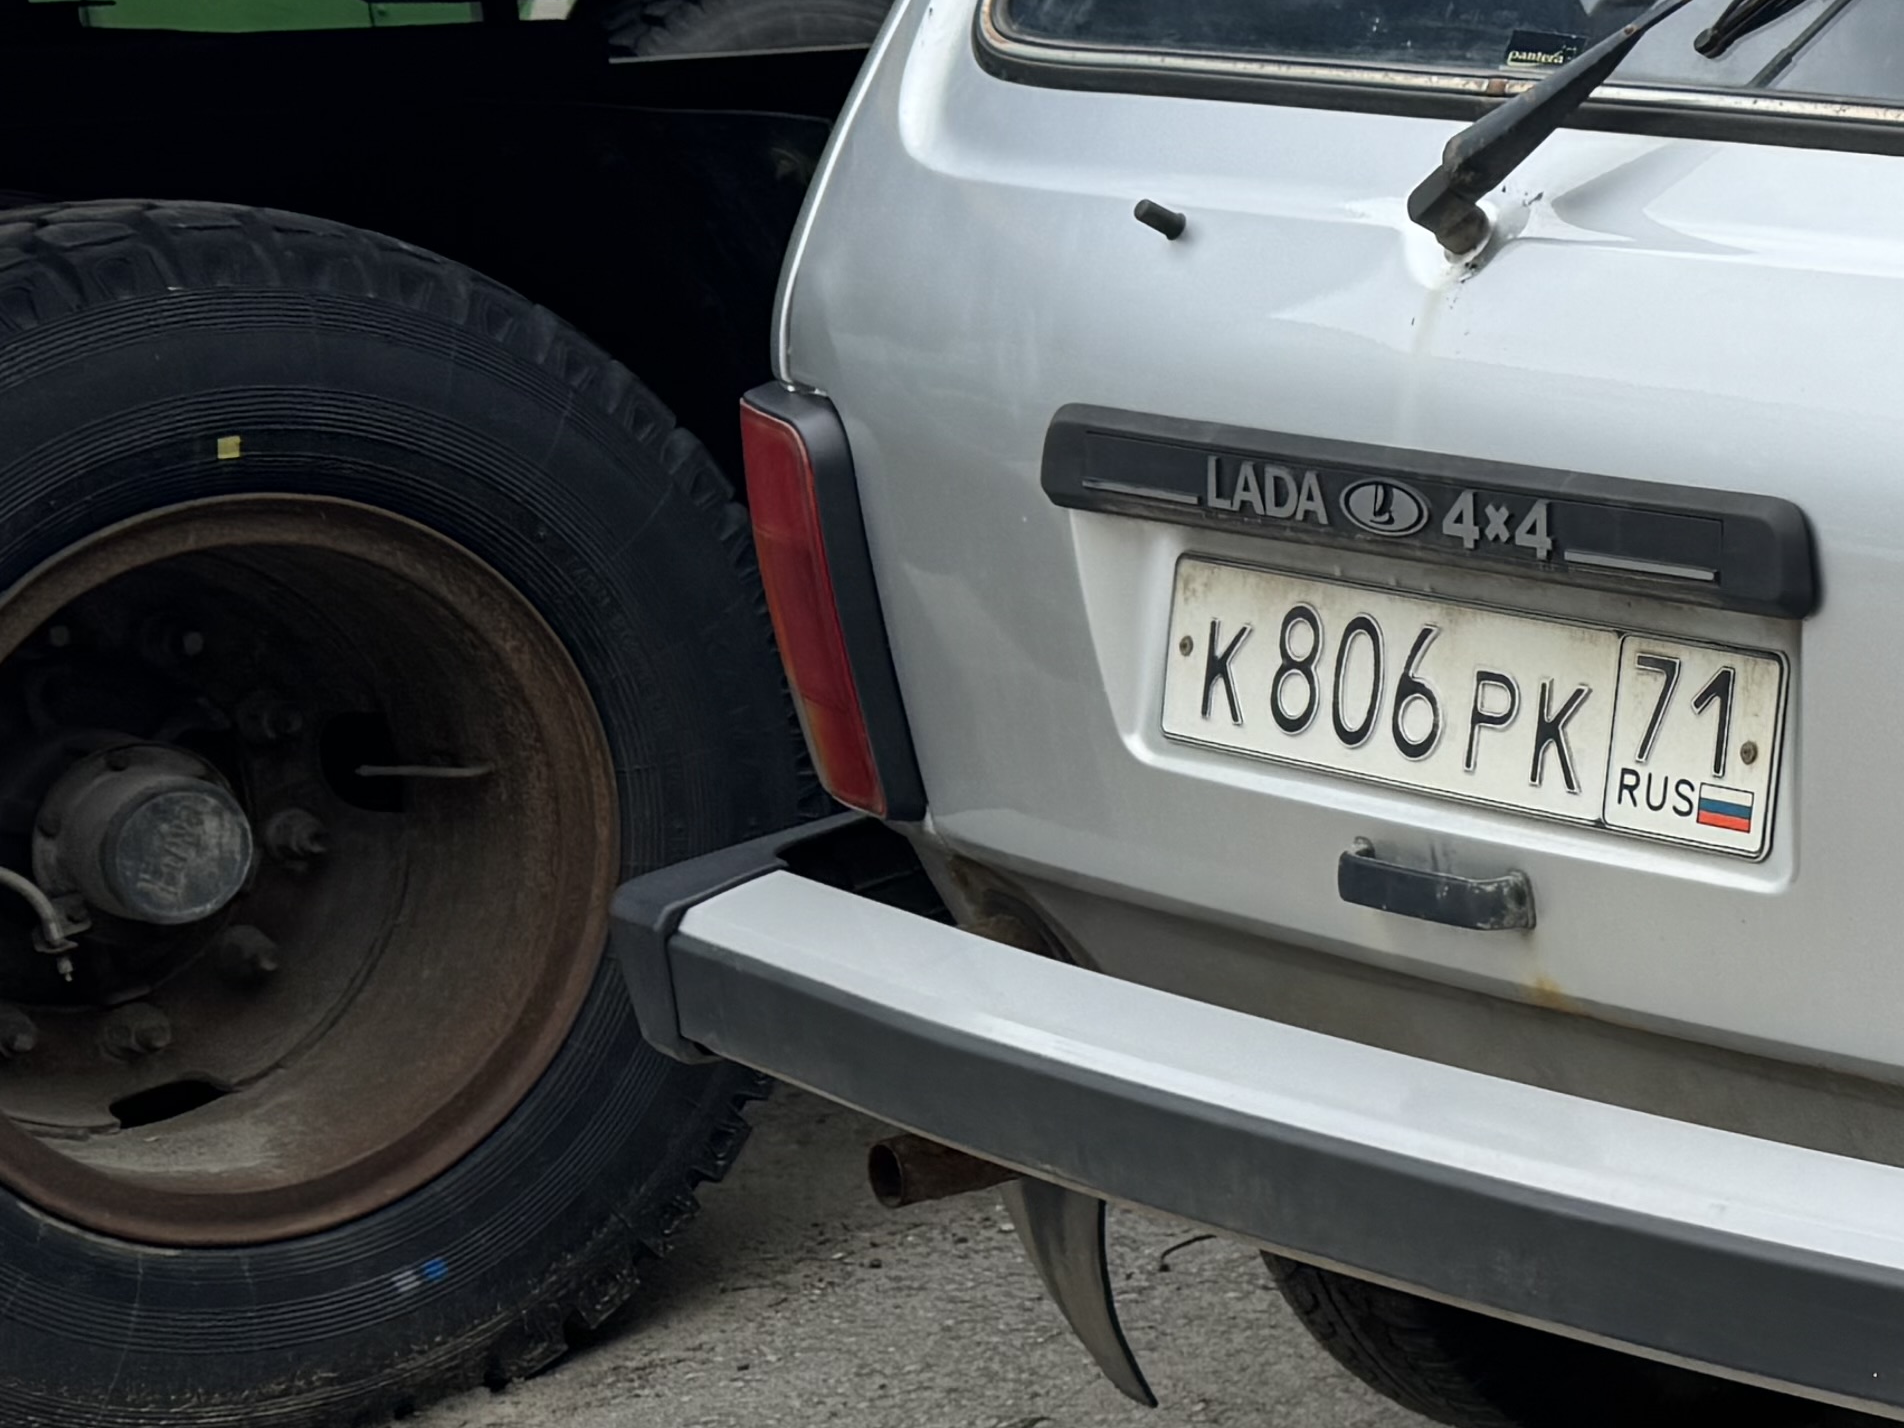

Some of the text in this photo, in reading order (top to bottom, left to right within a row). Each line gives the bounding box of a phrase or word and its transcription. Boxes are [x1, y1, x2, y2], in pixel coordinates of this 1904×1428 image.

[1207, 456, 1330, 525] LADA
[1635, 655, 1735, 778] 71
[1617, 767, 1695, 818] RUS
